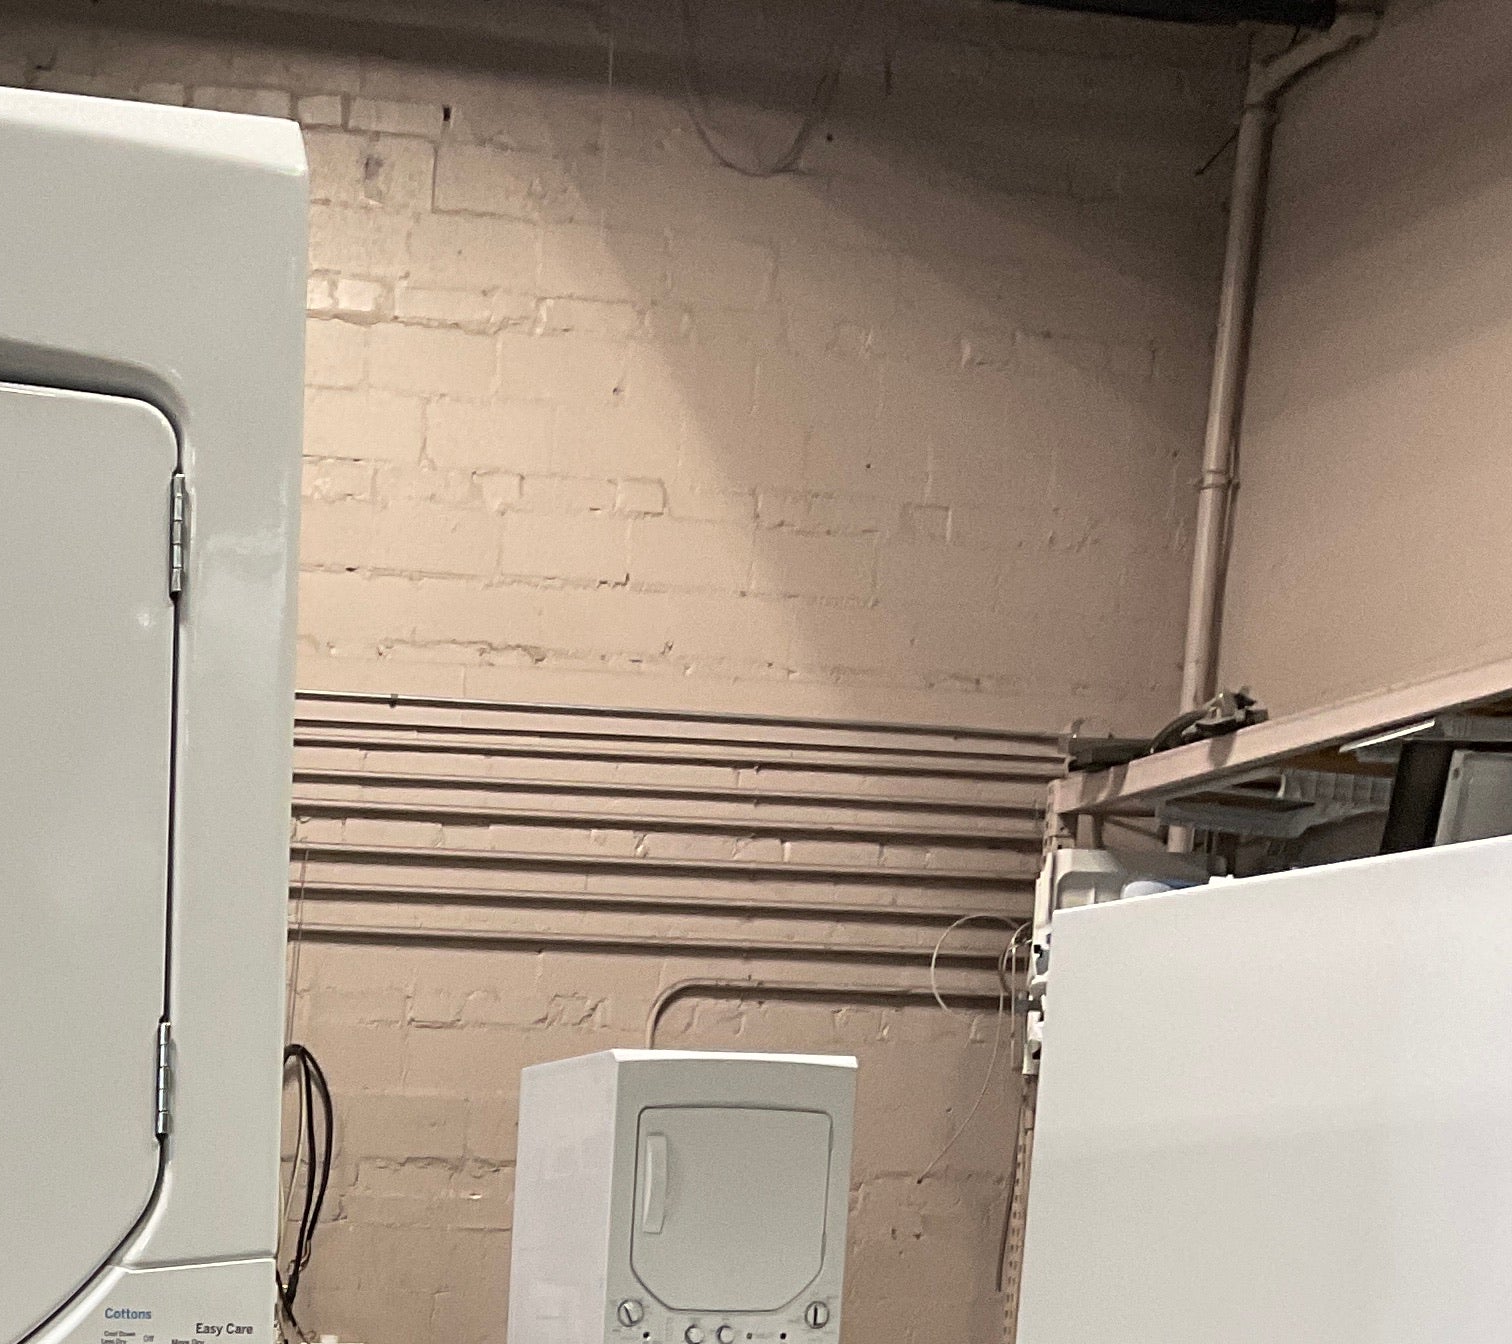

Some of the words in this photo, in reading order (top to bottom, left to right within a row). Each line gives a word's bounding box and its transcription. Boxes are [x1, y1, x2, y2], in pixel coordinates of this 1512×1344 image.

[104, 1307, 152, 1320] Cottons
[195, 1323, 223, 1336] Easy
[226, 1323, 253, 1334] Care
